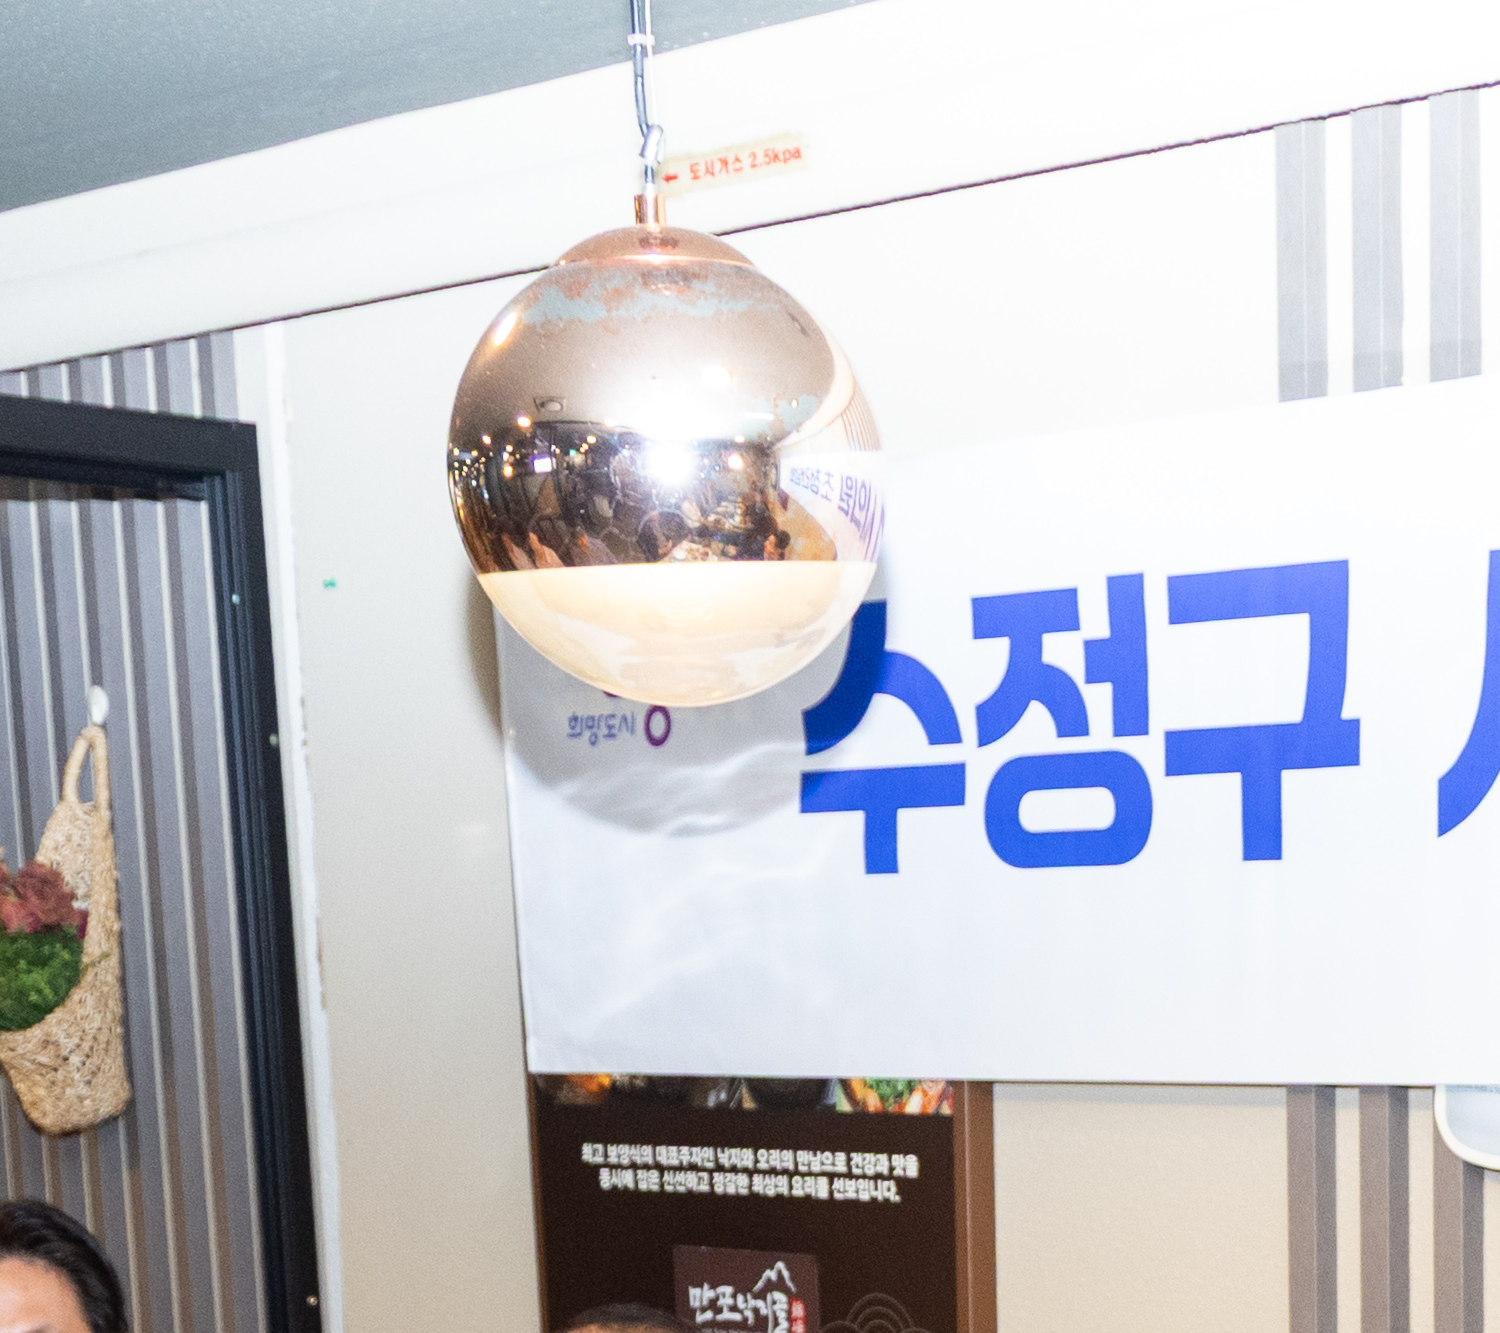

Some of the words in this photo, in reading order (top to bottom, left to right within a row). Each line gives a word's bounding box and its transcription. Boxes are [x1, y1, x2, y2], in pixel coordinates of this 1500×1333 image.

[566, 711, 637, 746] 희망도시
[797, 558, 1362, 876] 수정구
[581, 1142, 605, 1165] 최고
[606, 1144, 654, 1167] 보양식의
[655, 1145, 716, 1169] 대표주자인
[717, 1147, 754, 1170] 낙지와
[756, 1149, 794, 1171] 오리의
[796, 1150, 848, 1174] 만남으로
[850, 1152, 890, 1176] 건강과
[891, 1153, 919, 1179] 맛을
[599, 1168, 636, 1190] 동시에
[636, 1169, 660, 1192] 잡은
[663, 1170, 711, 1193] 신선하고
[712, 1172, 749, 1196] 정갈한
[751, 1173, 790, 1197] 최상의
[791, 1175, 830, 1200] 요리를
[831, 1177, 901, 1203] 선보입니다.
